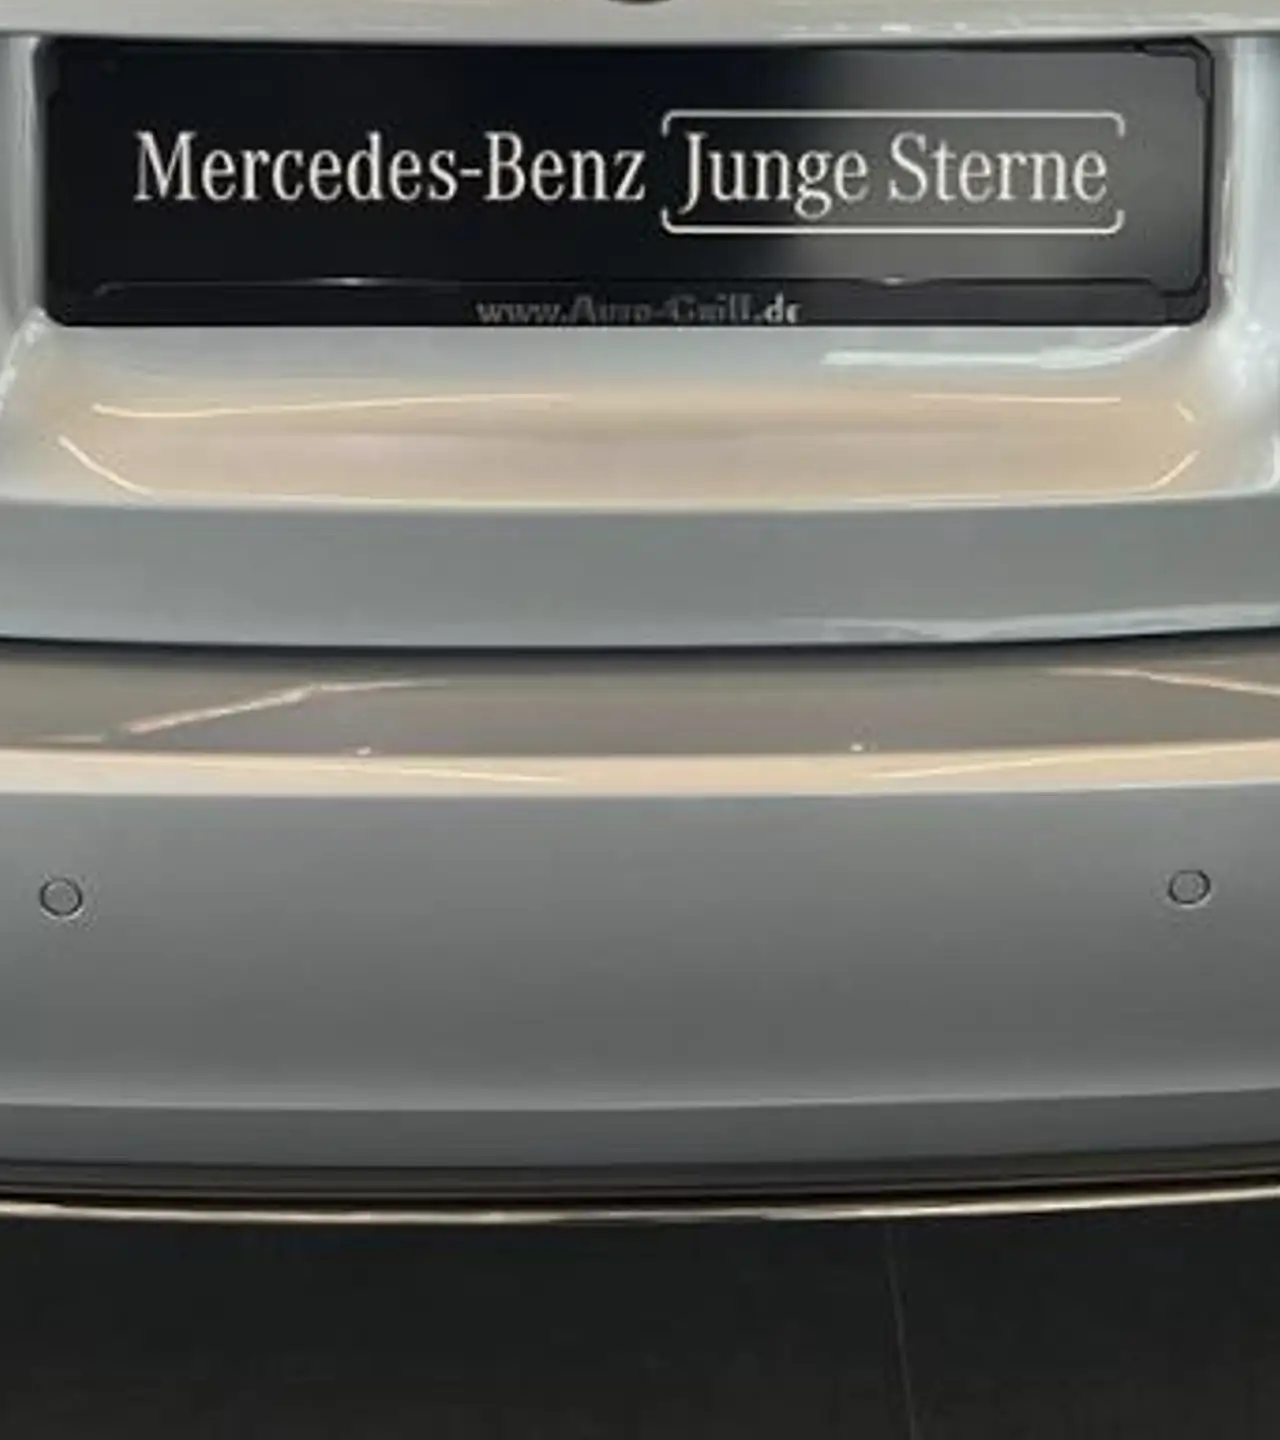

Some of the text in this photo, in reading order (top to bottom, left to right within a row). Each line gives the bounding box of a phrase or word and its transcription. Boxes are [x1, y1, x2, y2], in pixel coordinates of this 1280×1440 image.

[133, 130, 1108, 220] Mercedes-Benz Junge Sterne
